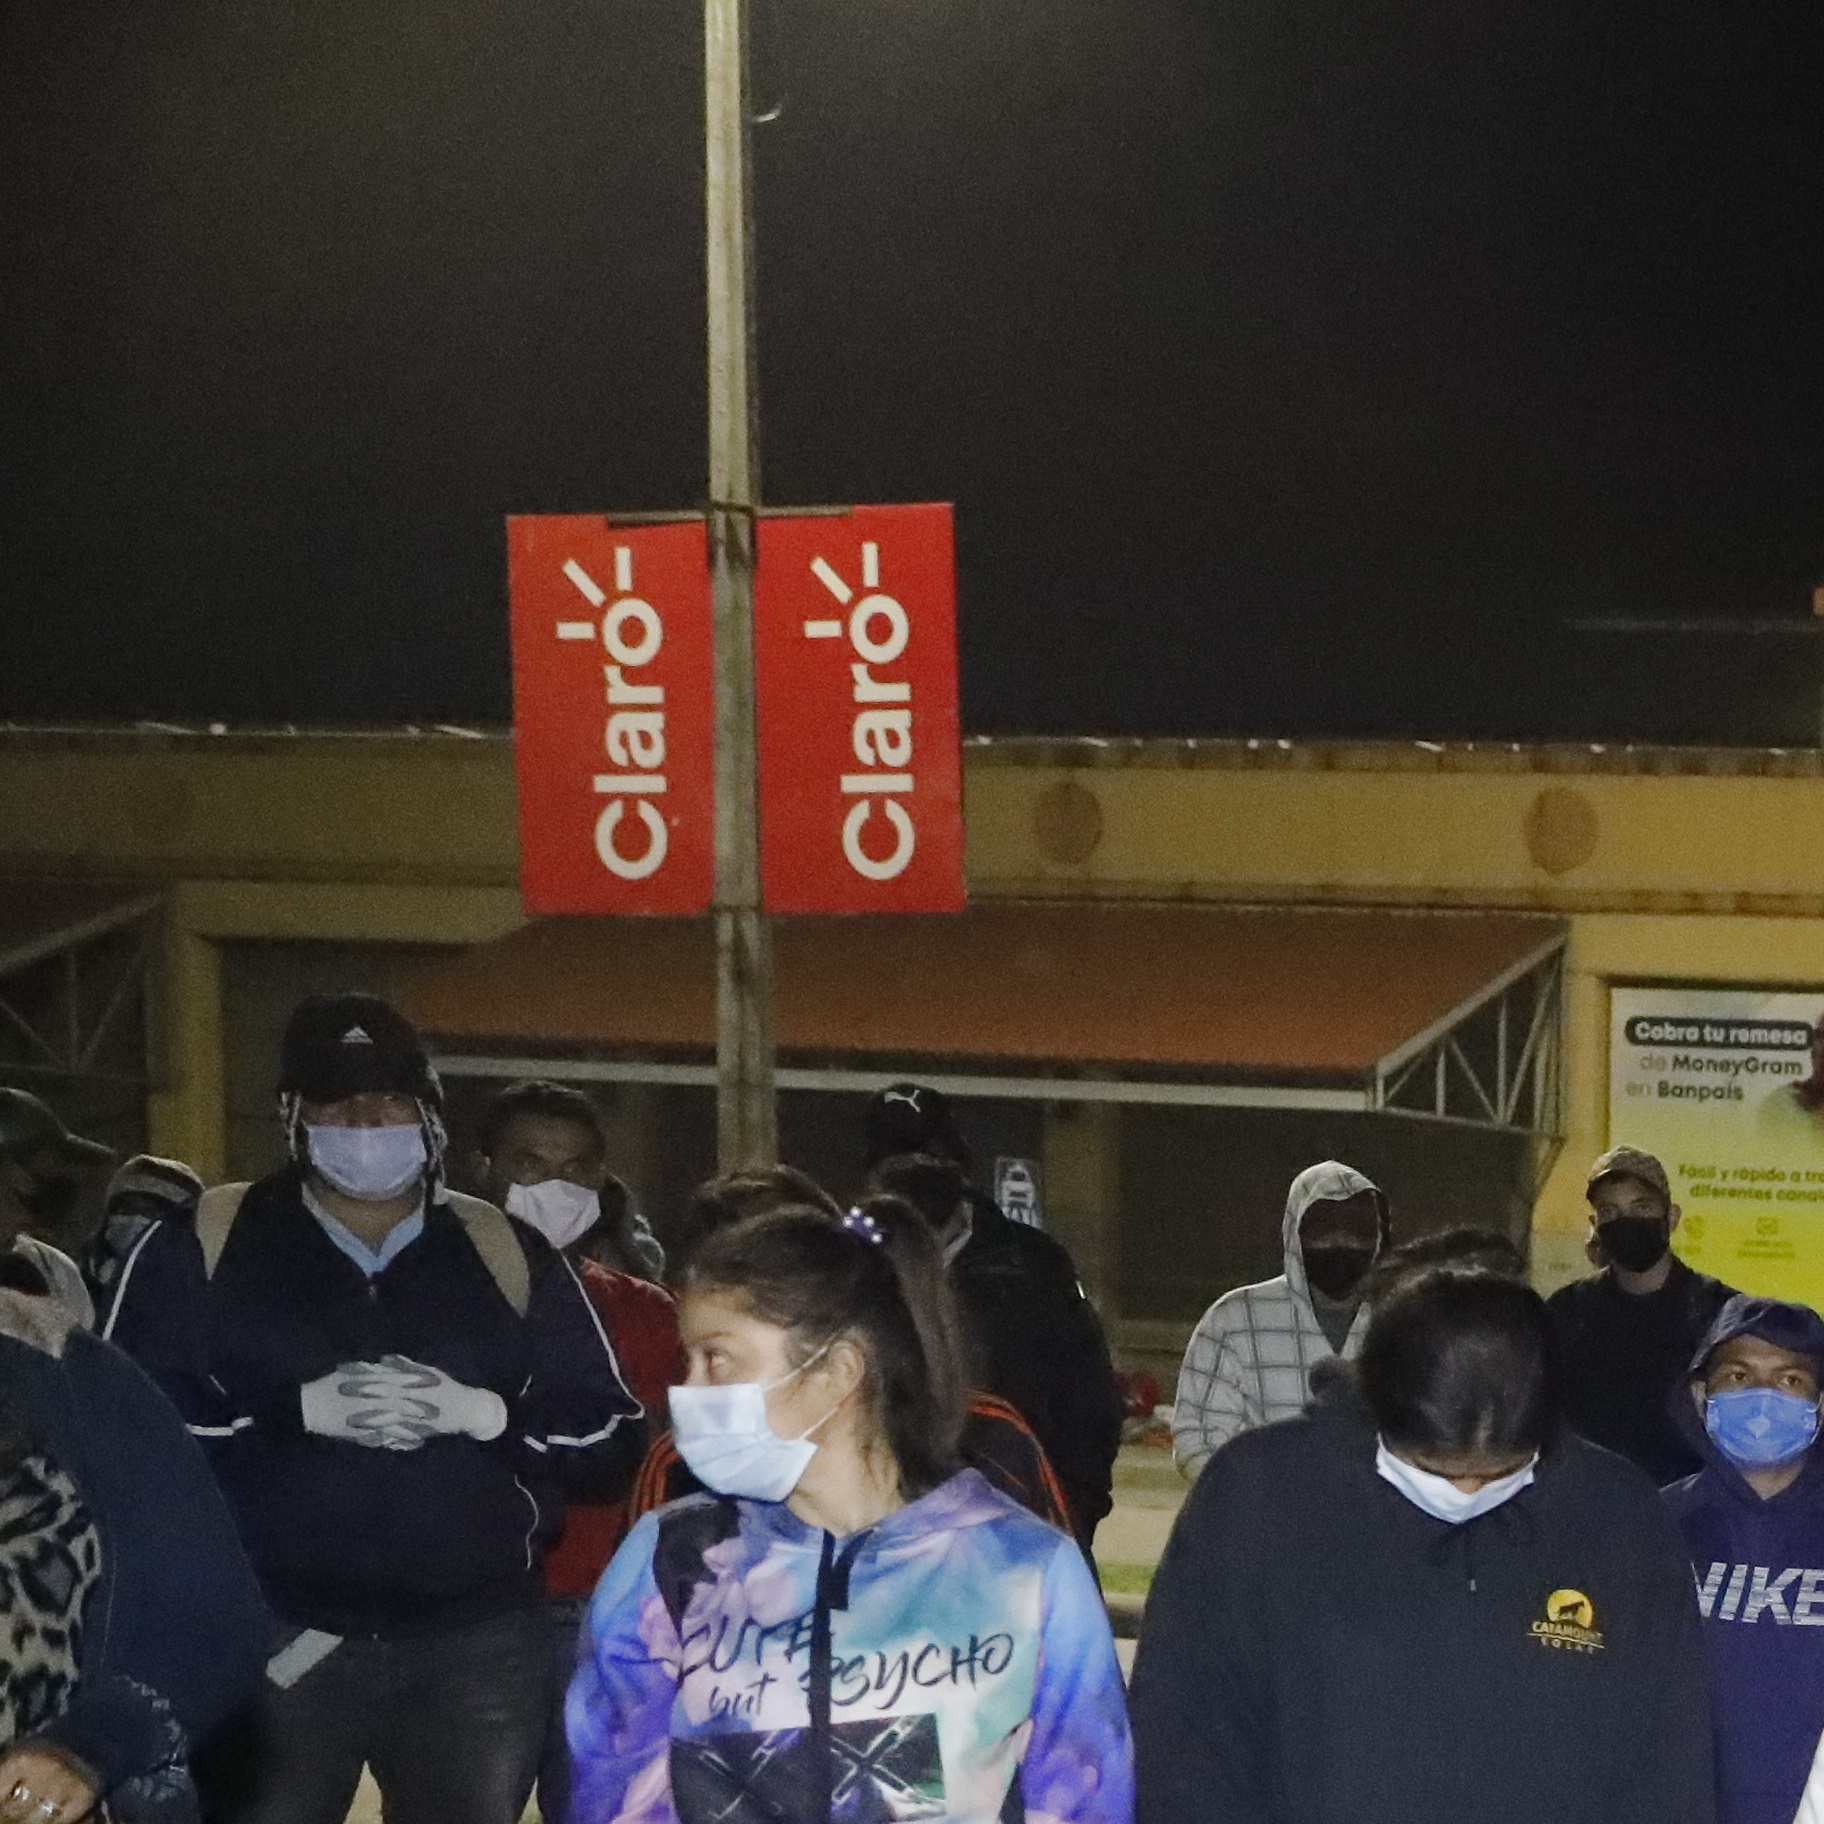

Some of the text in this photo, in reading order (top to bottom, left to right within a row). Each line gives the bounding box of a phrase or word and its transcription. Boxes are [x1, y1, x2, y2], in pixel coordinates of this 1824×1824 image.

[594, 598, 667, 880] Claro
[841, 594, 914, 880] Claro
[1635, 1021, 1808, 1045] Cobra tu remesa
[1640, 1054, 1804, 1077] de MoneyGram
[1720, 1168, 1728, 1181] y
[1689, 1184, 1772, 1201] diferentes
[708, 1672, 777, 1718] but
